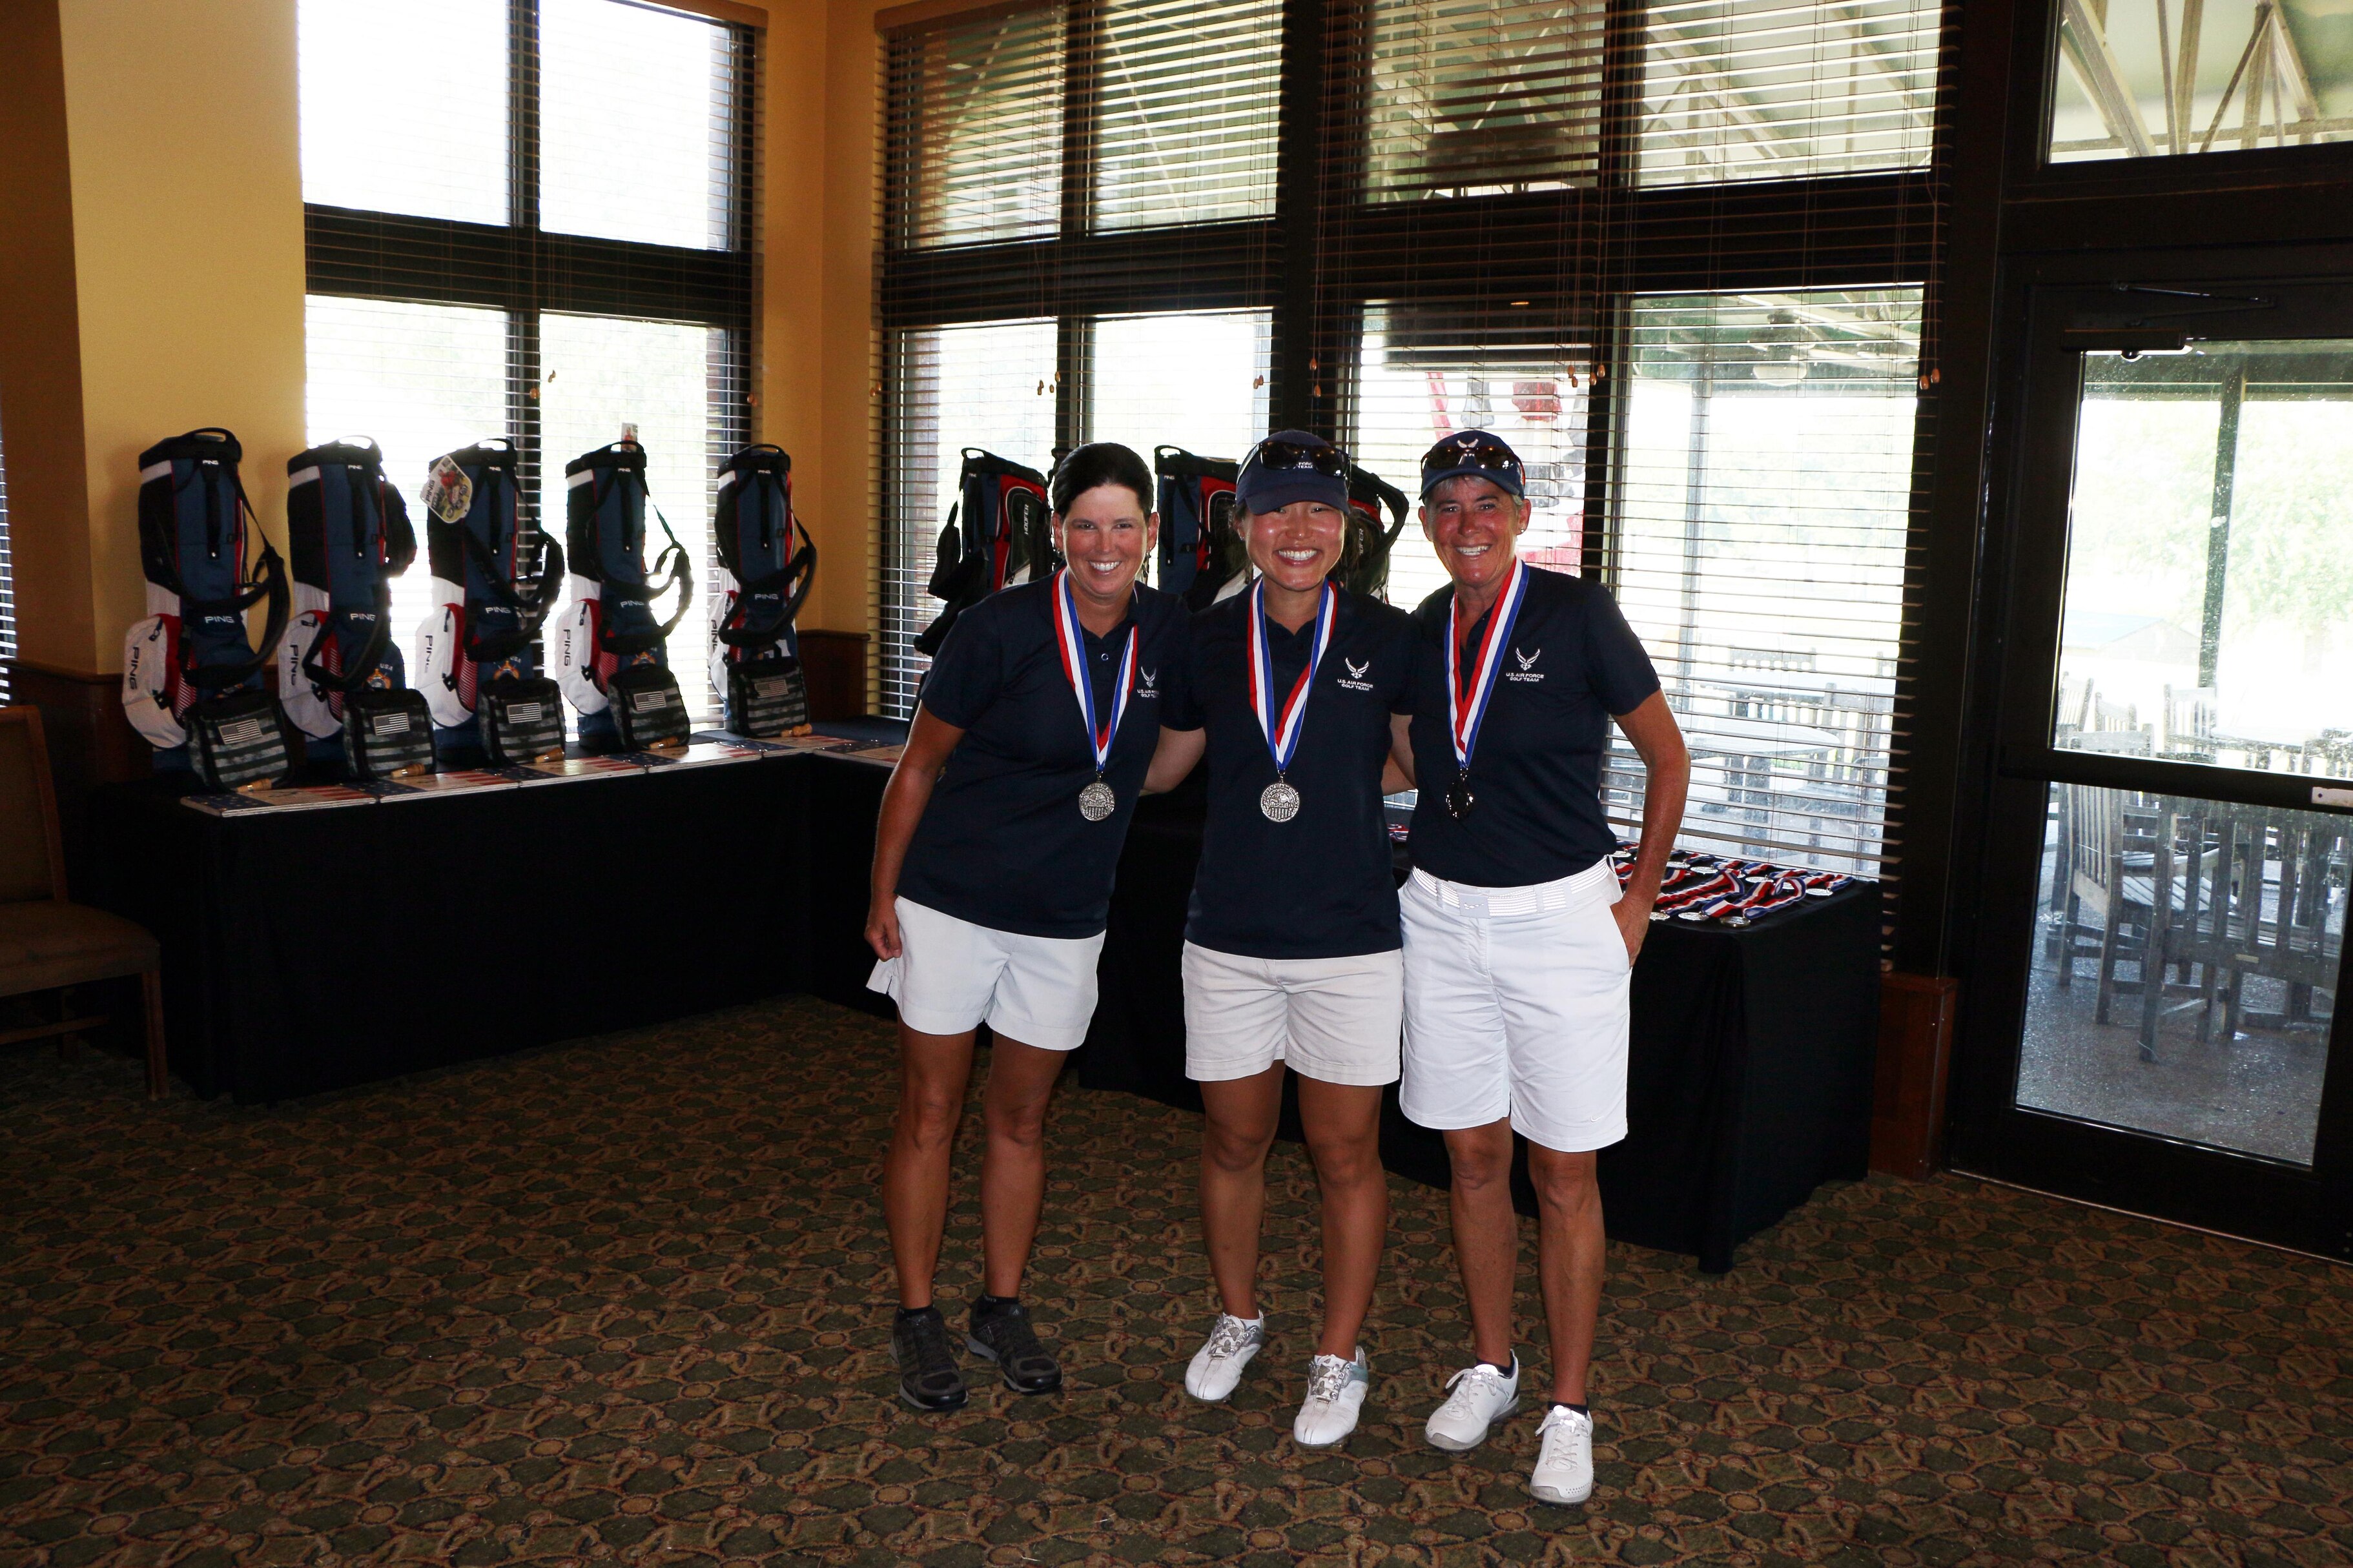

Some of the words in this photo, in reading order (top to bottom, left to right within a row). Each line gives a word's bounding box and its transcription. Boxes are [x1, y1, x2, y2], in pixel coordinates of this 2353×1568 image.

[426, 480, 435, 502] PING
[205, 615, 235, 624] PING
[130, 646, 139, 690] PING
